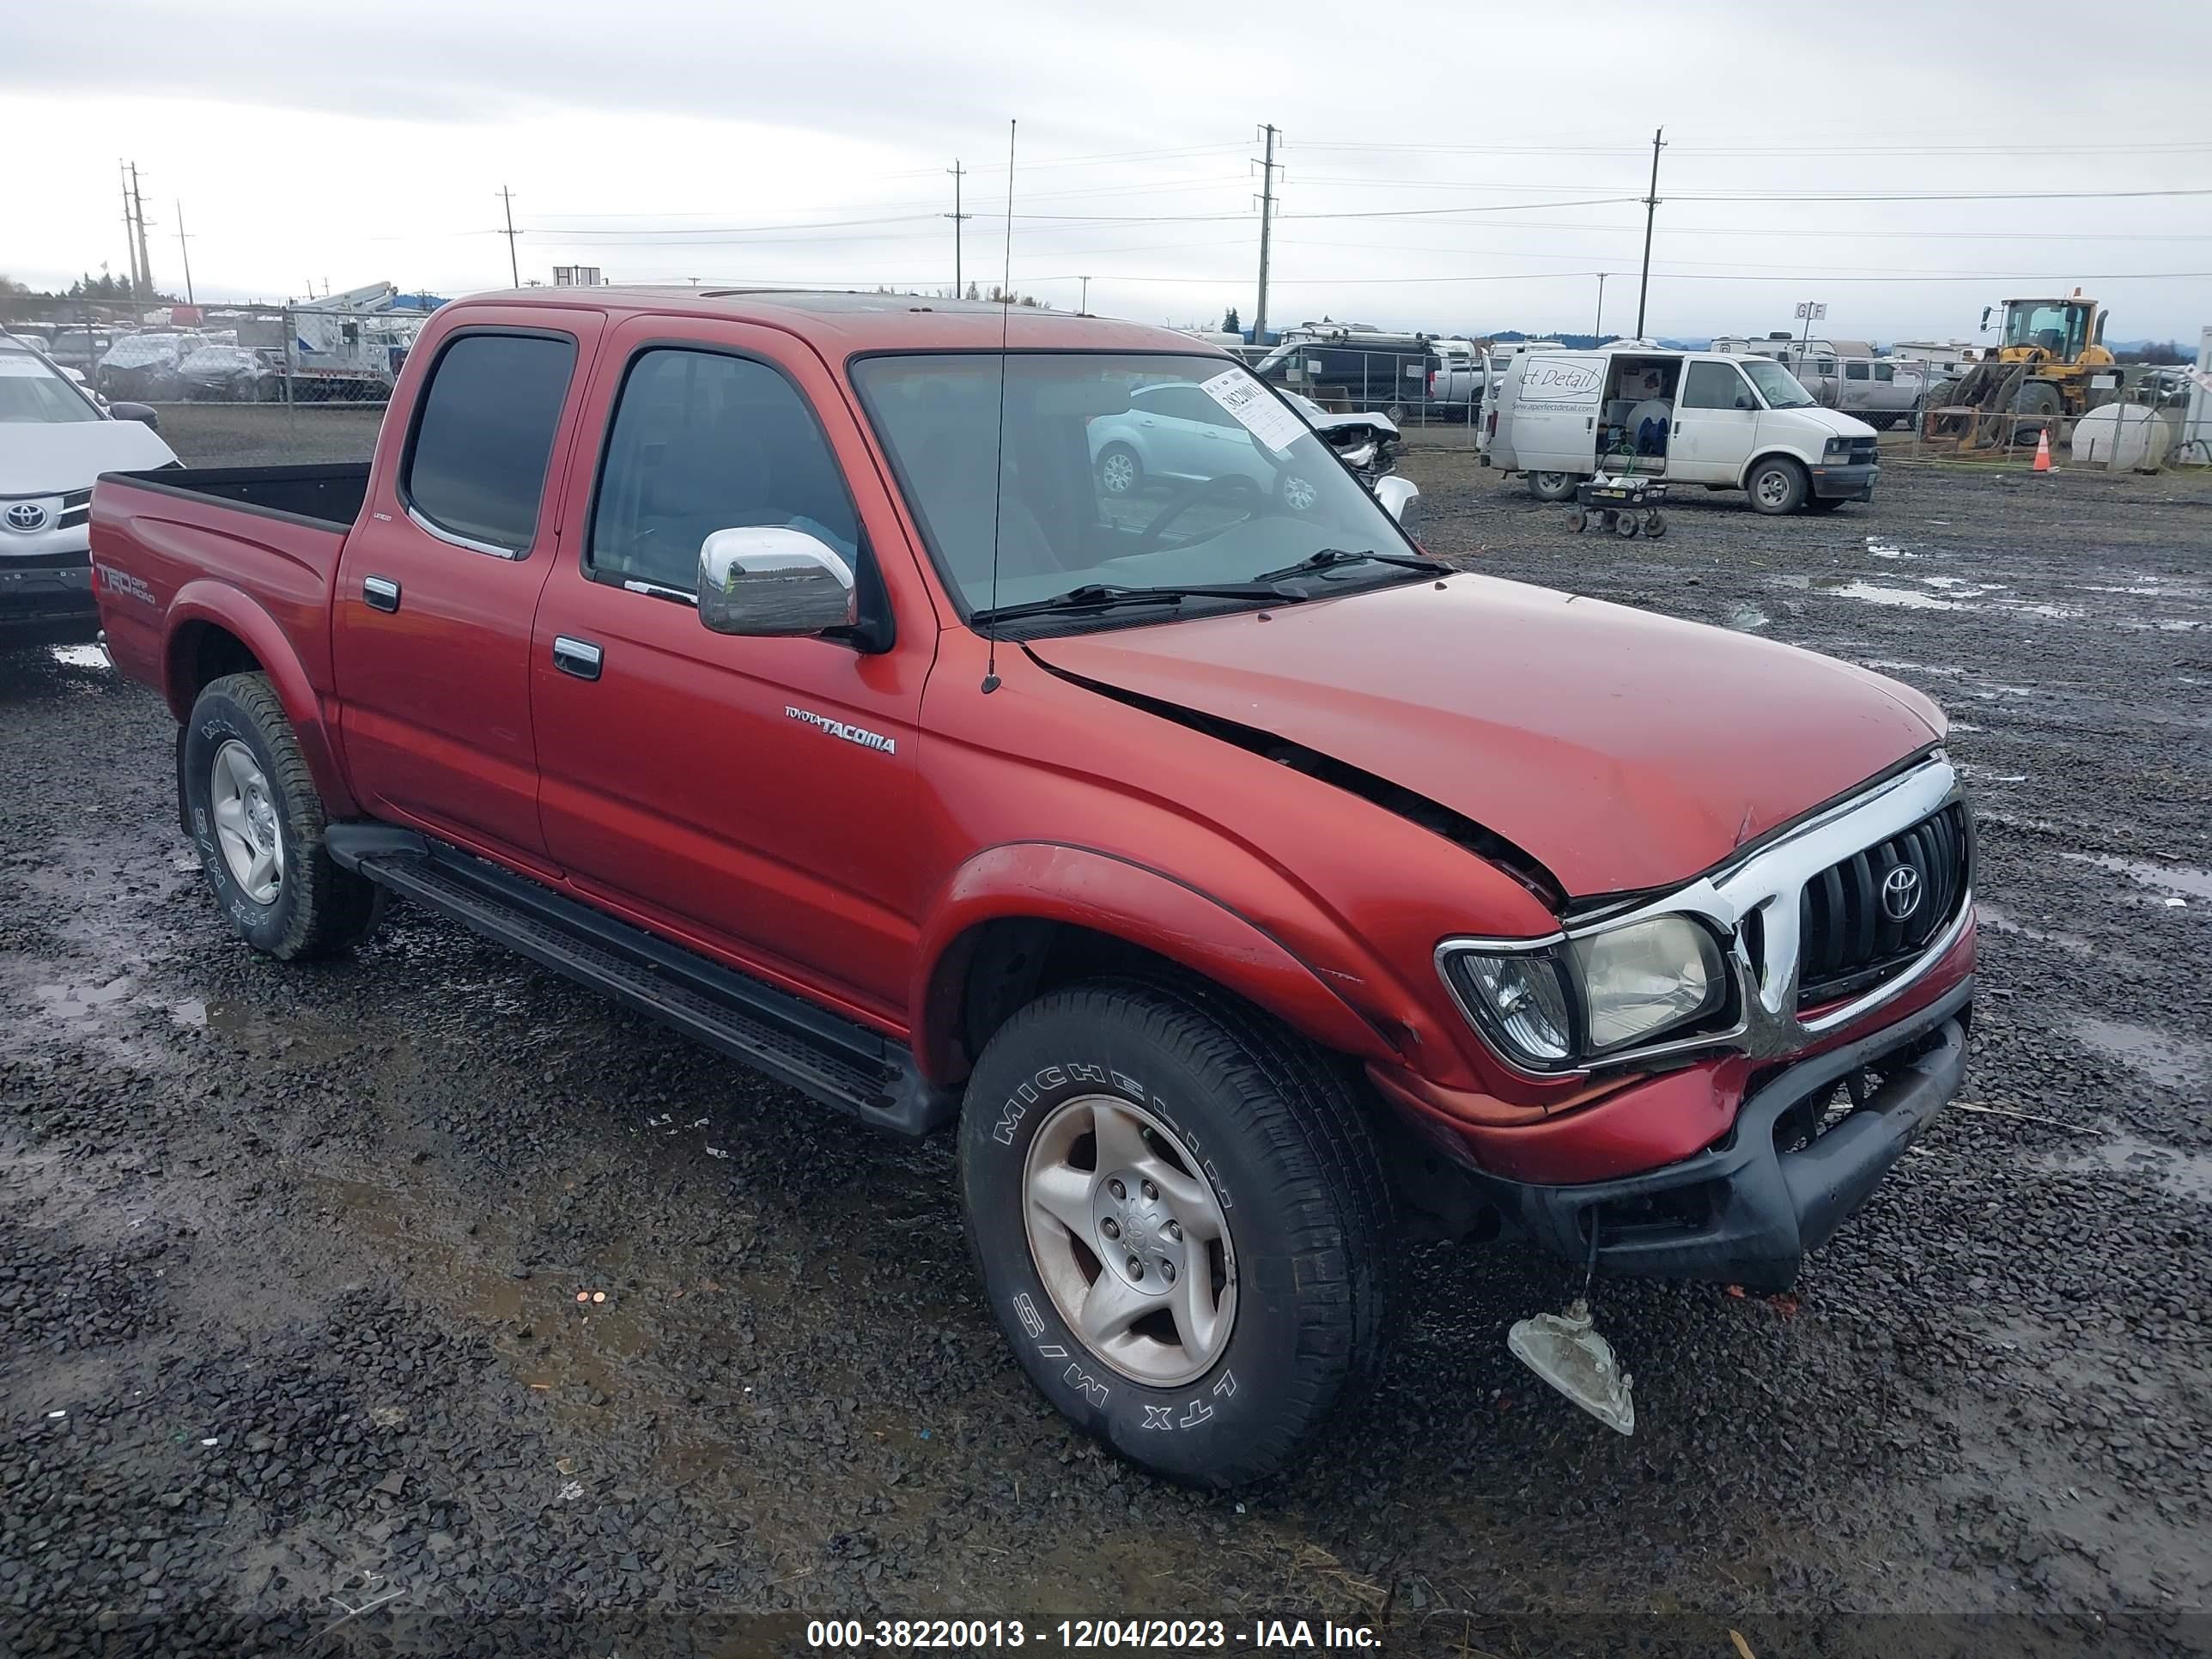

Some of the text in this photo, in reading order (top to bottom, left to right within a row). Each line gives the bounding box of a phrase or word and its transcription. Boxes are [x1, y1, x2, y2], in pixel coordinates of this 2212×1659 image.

[1797, 303, 1824, 318] G F
[1541, 368, 1598, 389] Detail
[1222, 382, 1263, 410] 38220013
[95, 562, 148, 595] TRD OFF
[131, 586, 155, 604] ROAD
[785, 705, 896, 755] TOYOTA TACOMA
[993, 1064, 1233, 1209] MICHELIN
[1141, 1368, 1237, 1431] LTX
